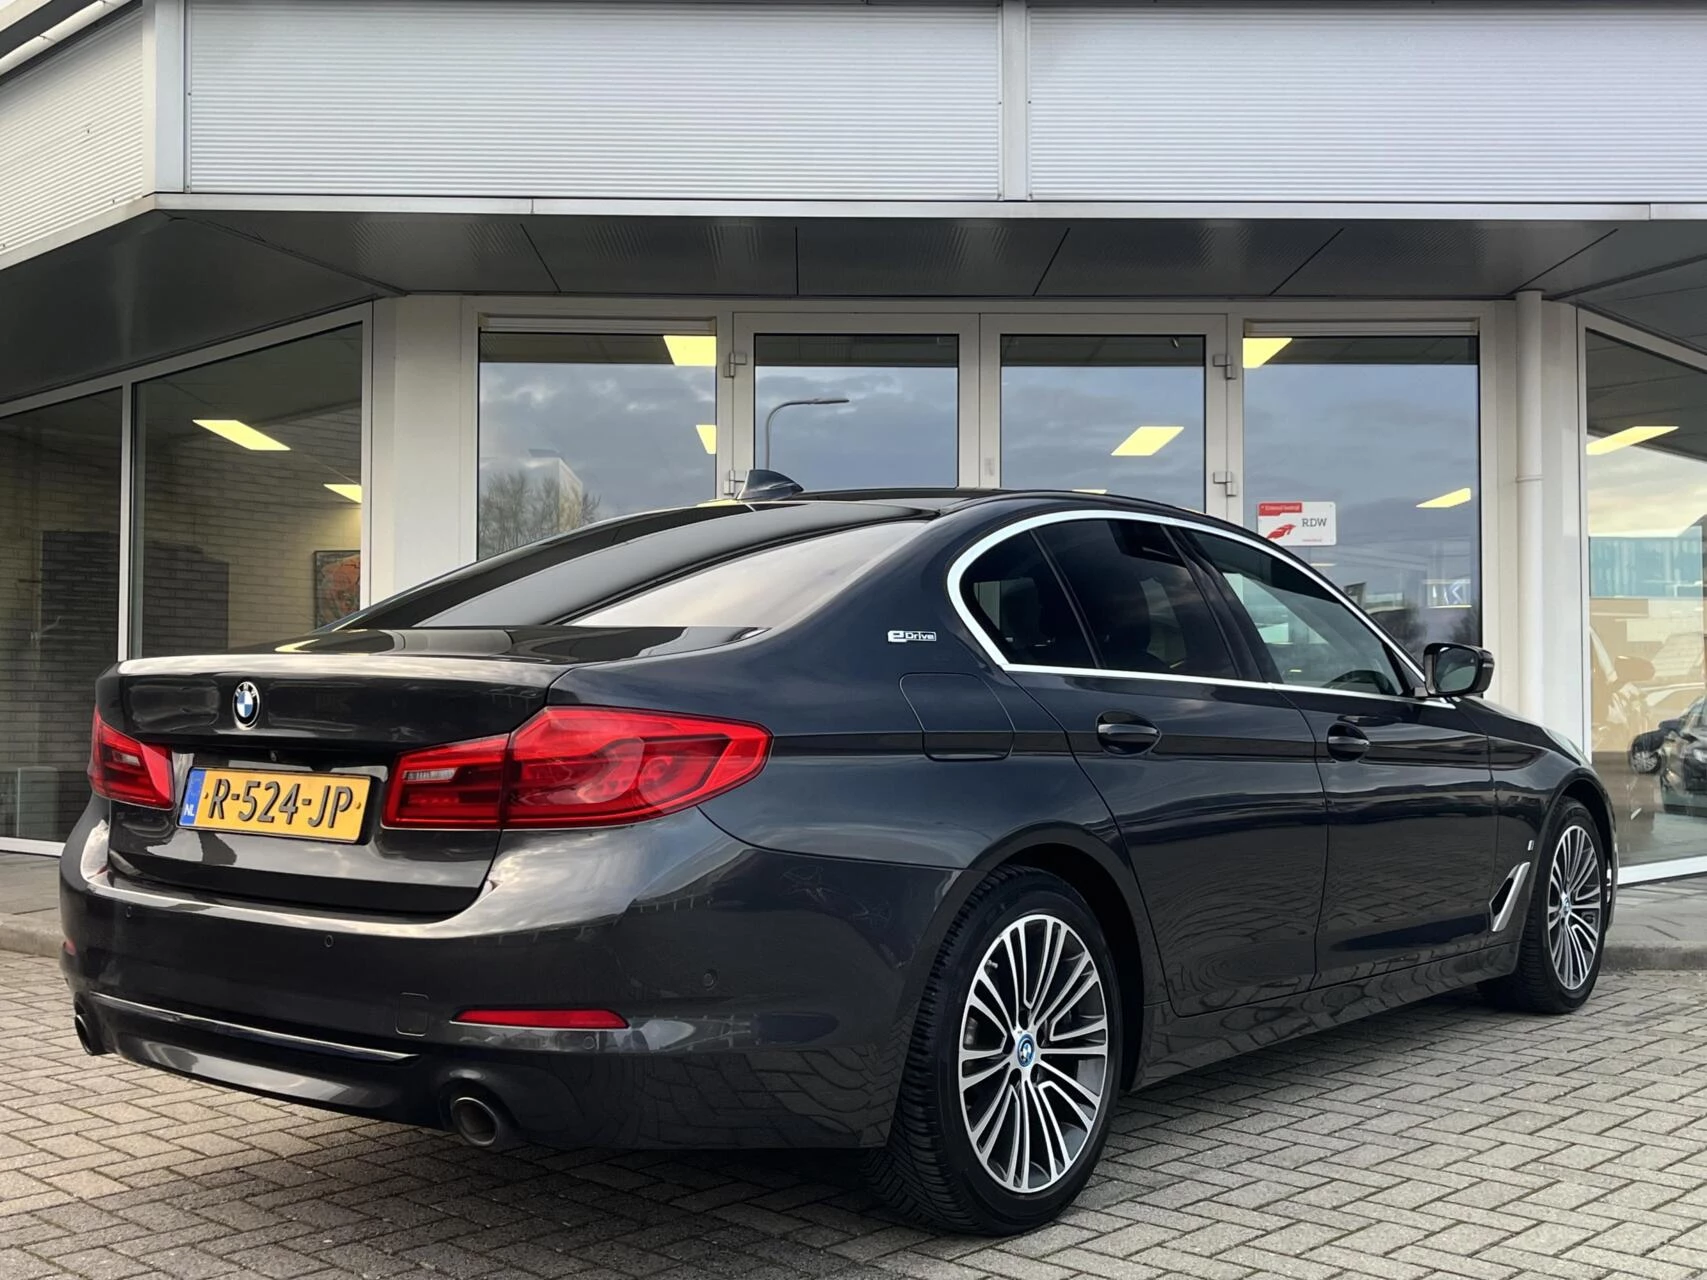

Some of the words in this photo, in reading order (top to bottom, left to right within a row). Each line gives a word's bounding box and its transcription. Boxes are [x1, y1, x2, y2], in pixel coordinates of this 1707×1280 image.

[1301, 518, 1327, 527] RDW
[208, 778, 353, 828] R-524-JP
[183, 804, 195, 817] NL
